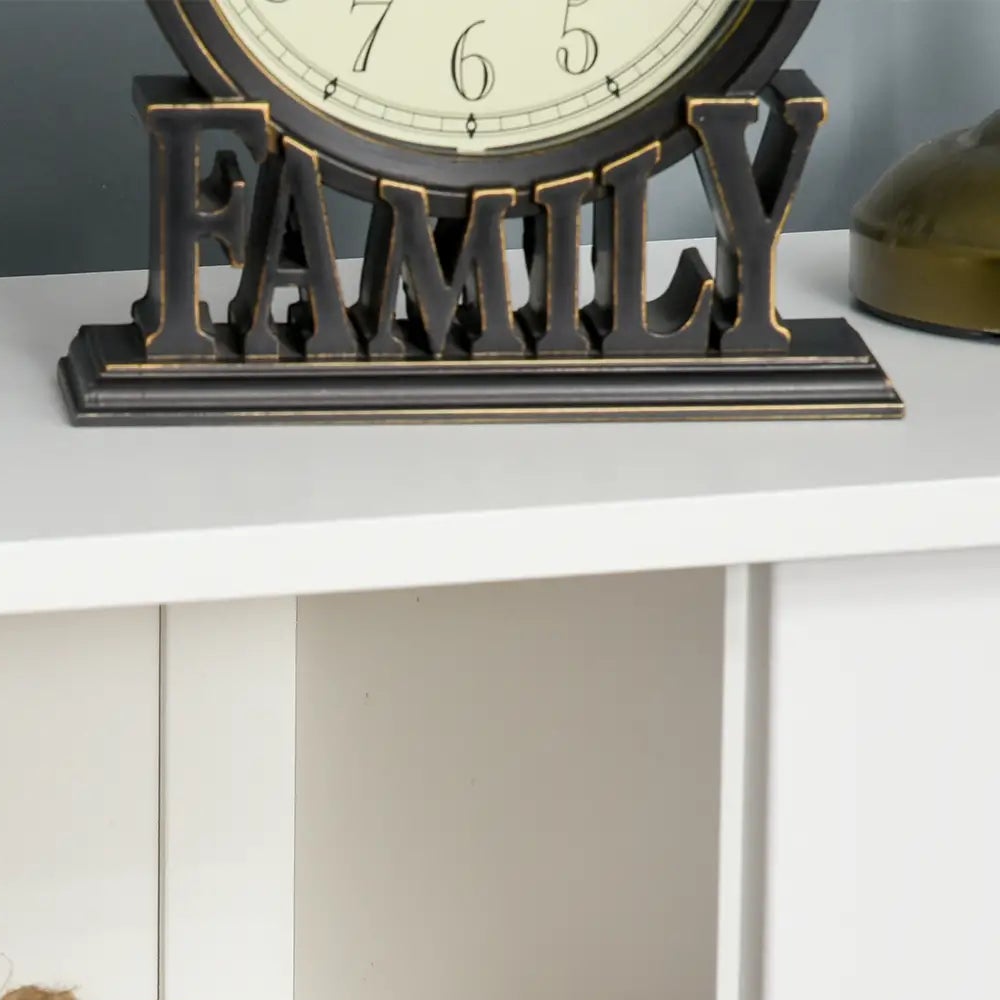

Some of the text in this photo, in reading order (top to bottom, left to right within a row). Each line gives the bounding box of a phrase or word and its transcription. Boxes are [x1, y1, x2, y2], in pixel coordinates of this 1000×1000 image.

[350, 0, 393, 73] 7
[450, 19, 496, 101] 6
[556, 0, 599, 75] 5
[145, 97, 828, 358] FAMILY
